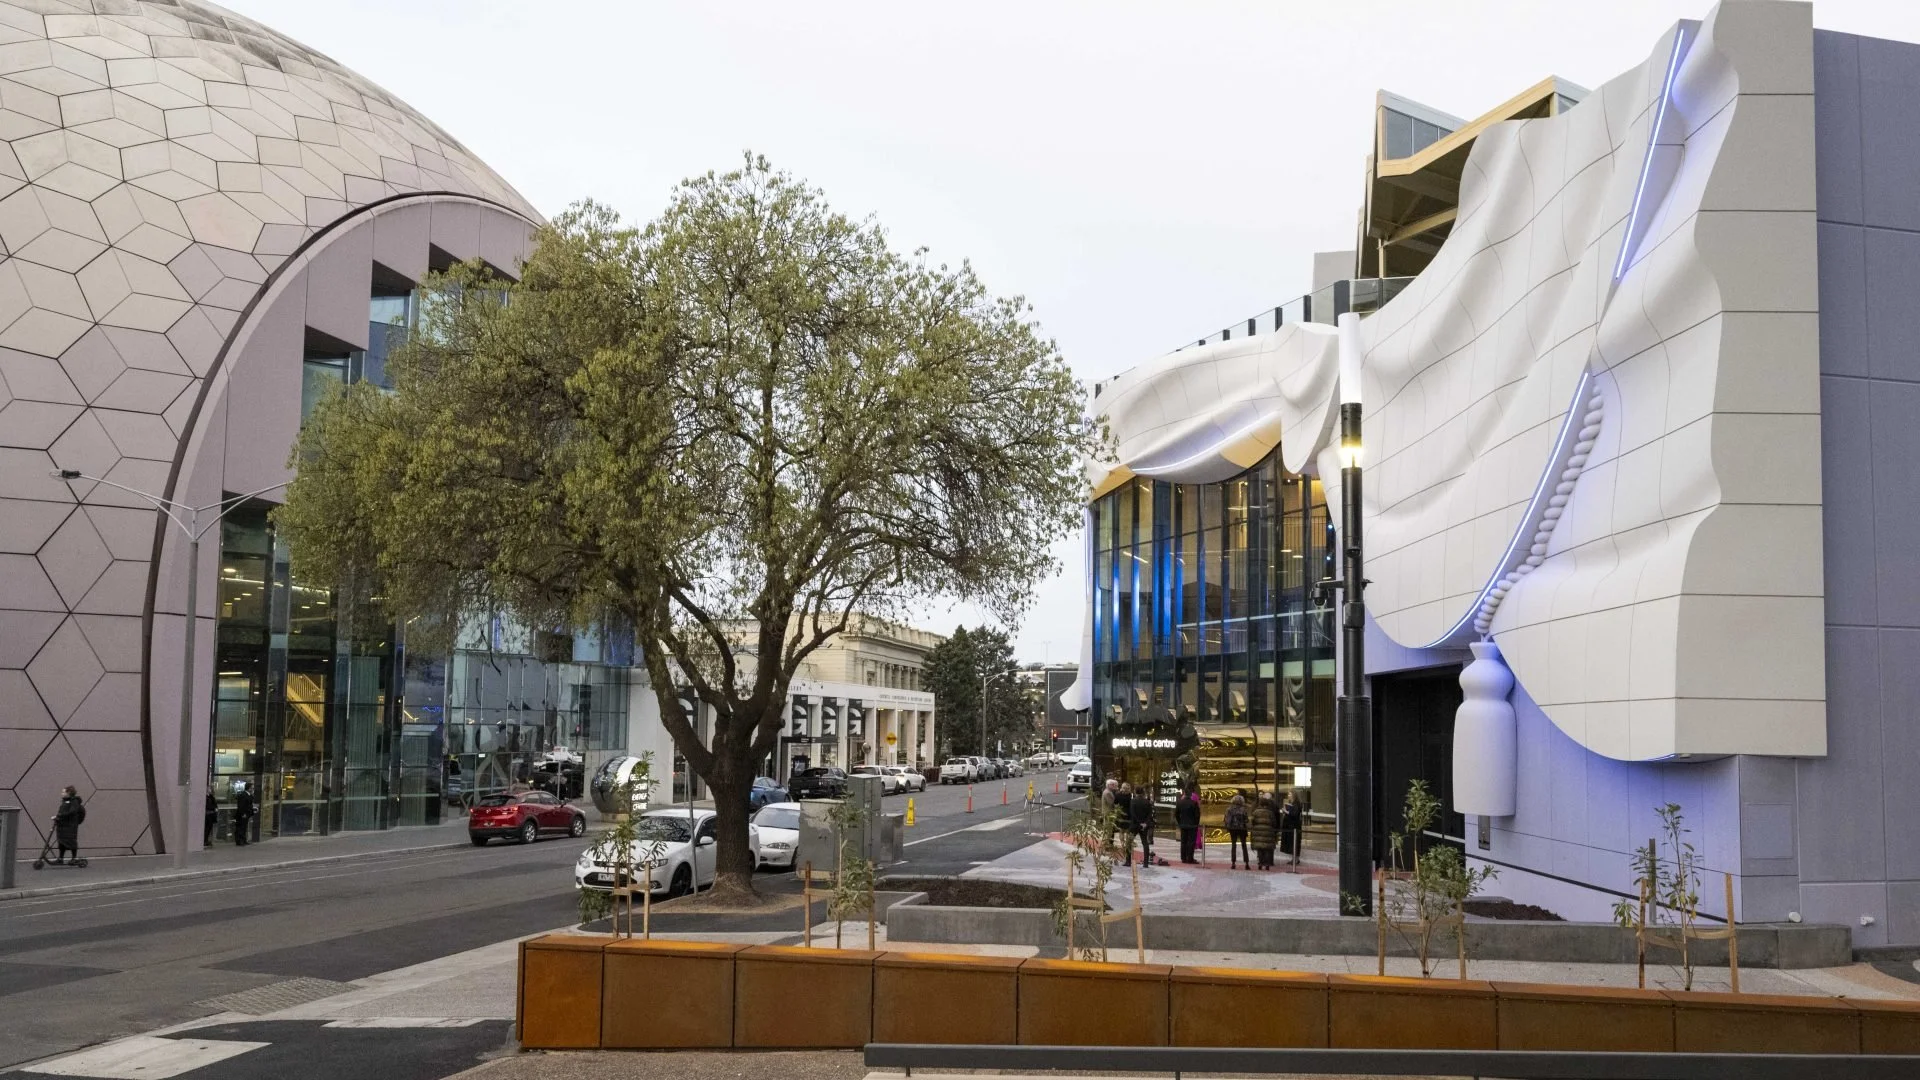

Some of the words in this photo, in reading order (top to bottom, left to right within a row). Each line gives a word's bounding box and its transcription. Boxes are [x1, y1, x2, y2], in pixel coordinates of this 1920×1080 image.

[1112, 737, 1137, 749] geelong
[1138, 738, 1152, 748] arts
[1153, 738, 1176, 748] centre
